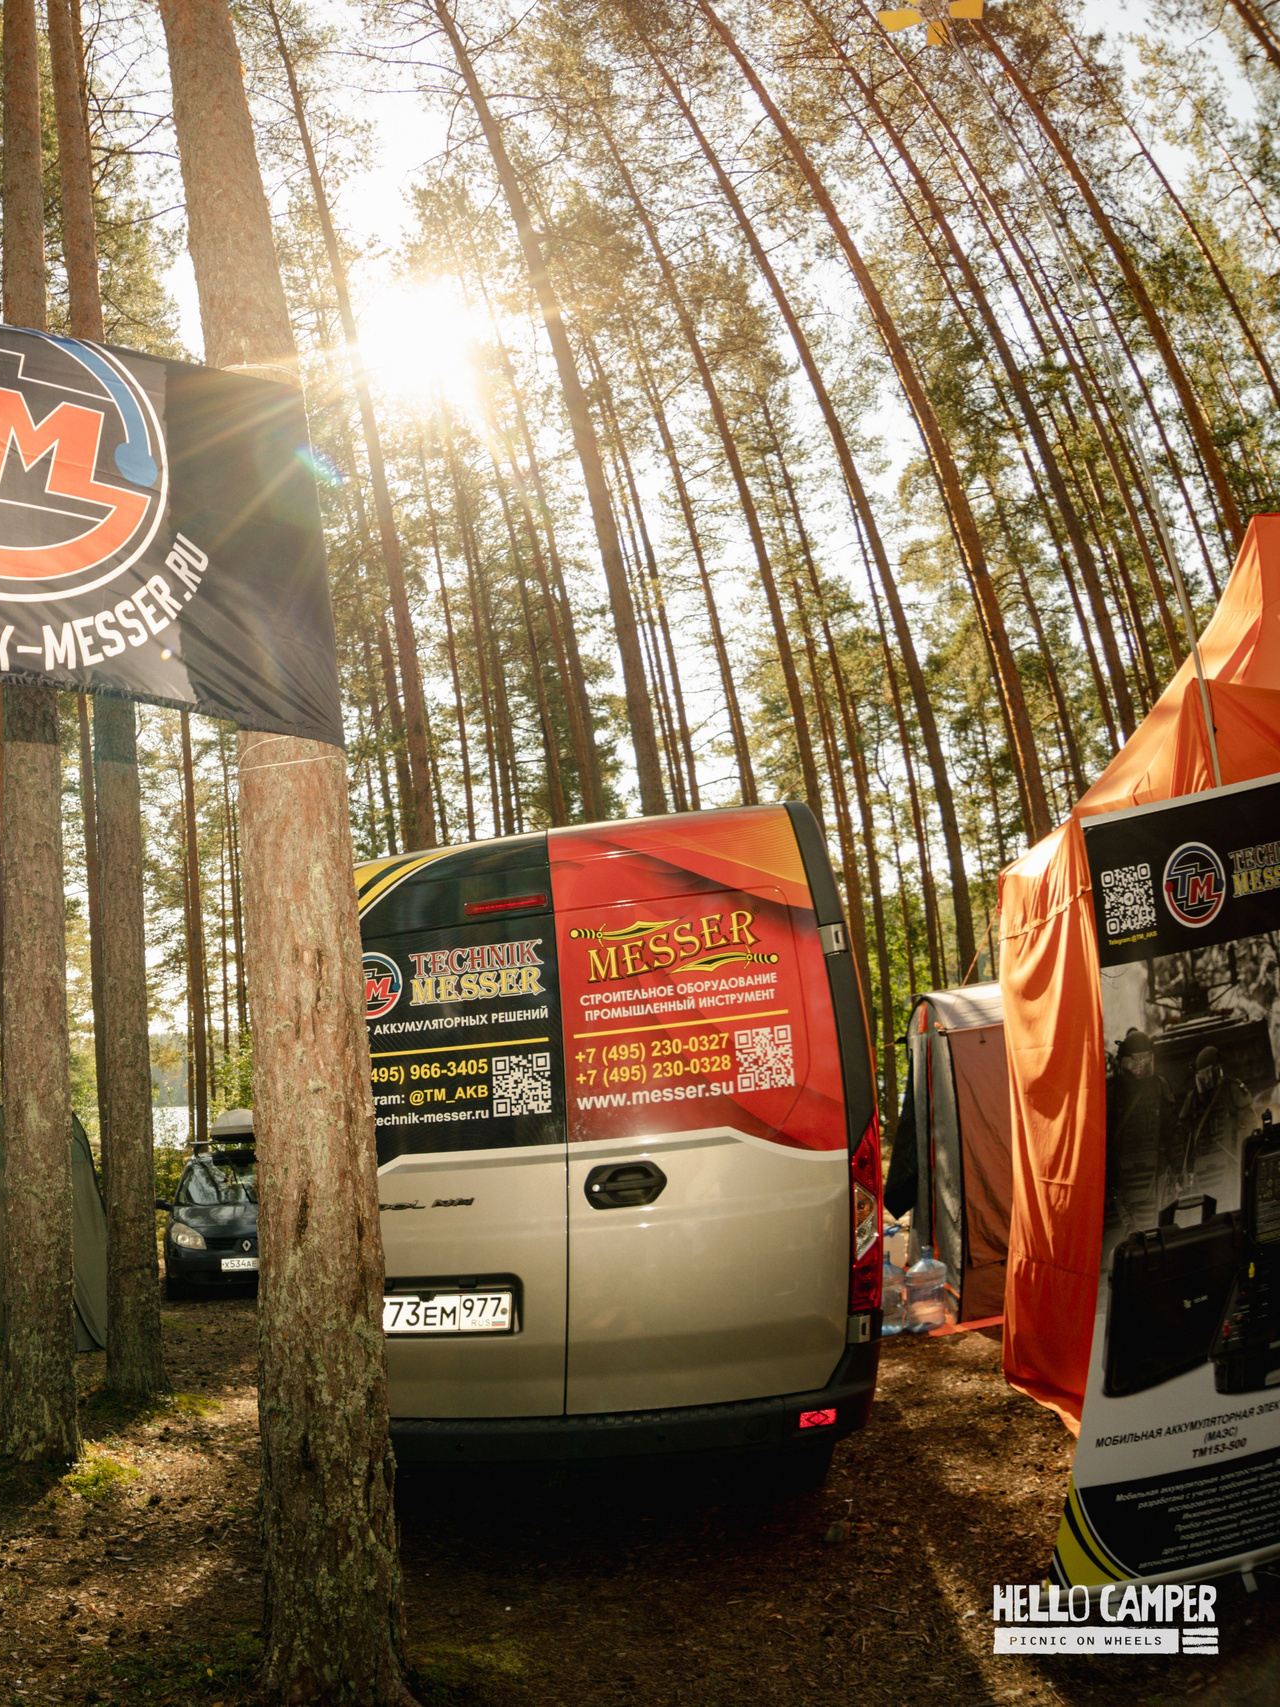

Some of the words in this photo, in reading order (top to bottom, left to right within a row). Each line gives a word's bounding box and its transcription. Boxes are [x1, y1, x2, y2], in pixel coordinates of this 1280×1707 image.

[1227, 841, 1280, 874] TECH
[1168, 867, 1222, 905] TM
[409, 939, 544, 979] TECHNIK
[587, 910, 761, 983] MESSER
[409, 967, 546, 1006] MESSER
[580, 984, 674, 1006] СТРОИТЕЛЬНОЕ
[676, 972, 778, 994] ОБОРУДОВАНИЕ
[374, 1013, 488, 1036] АККУМУЛЯТОРНЫХ
[491, 1005, 549, 1025] РЕШЕНИЙ
[584, 996, 695, 1022] ПРОМЫШЛЕННЫЙ
[698, 988, 775, 1008] ИНСТРУМЕНТ
[575, 1047, 596, 1064] +7
[602, 1042, 646, 1066] (495)
[651, 1032, 730, 1057] 230-0327
[371, 1065, 405, 1085] 495)
[410, 1058, 488, 1080] 966-3405
[576, 1069, 597, 1086] +7
[603, 1063, 647, 1088] (495)
[652, 1054, 732, 1079] 230-0328
[373, 1094, 405, 1106] ram:
[409, 1084, 489, 1106] @TM_AKB
[577, 1080, 734, 1110] www.messer.su
[382, 1301, 457, 1327] 73ЕМ
[462, 1296, 502, 1318] 977
[471, 1318, 491, 1327] RUS
[1095, 1428, 1163, 1449] МОБИЛЬНАЯ
[1164, 1407, 1255, 1436] АККУМУЛЯТОРНАЯ
[1203, 1426, 1238, 1444] (МАЭС)
[1192, 1437, 1247, 1459] TM153-500
